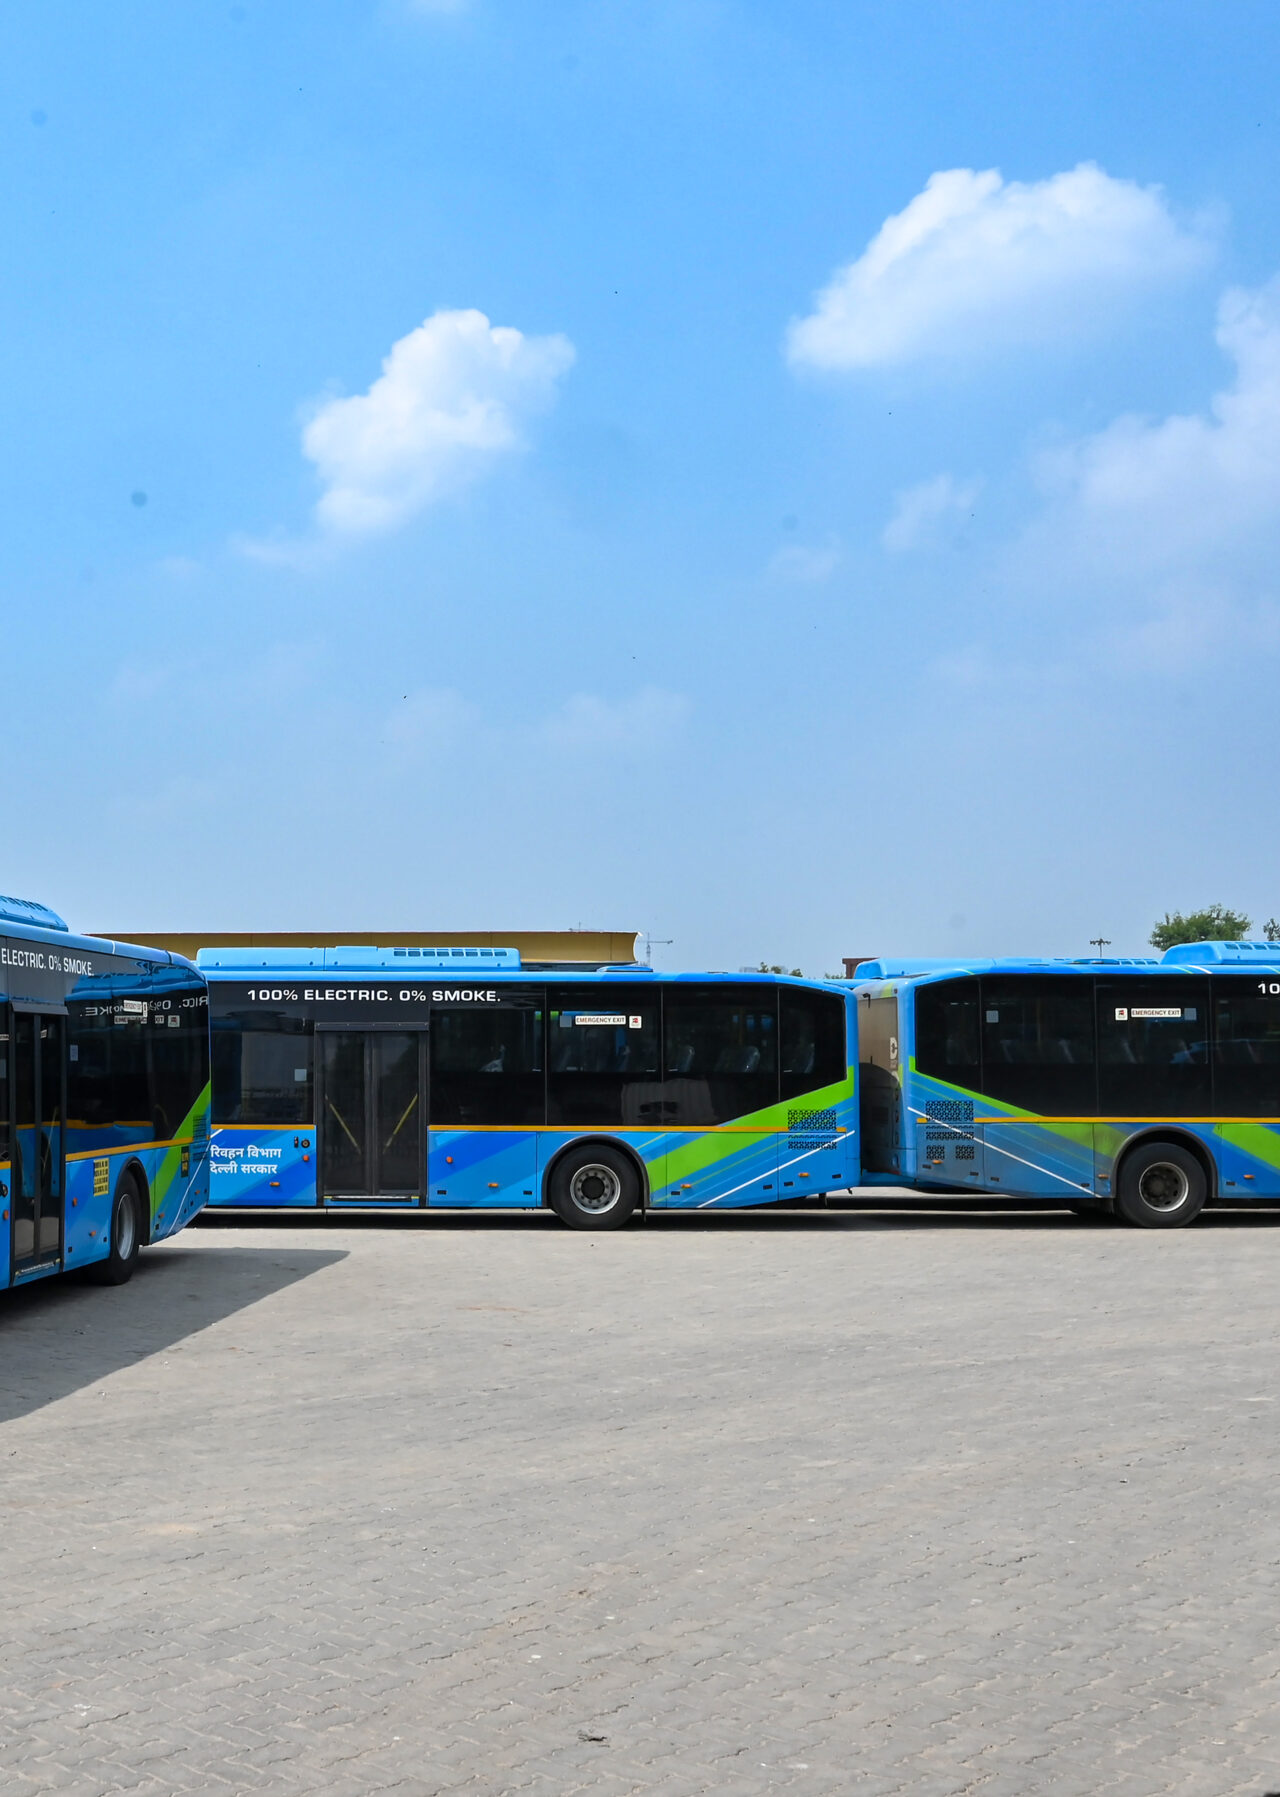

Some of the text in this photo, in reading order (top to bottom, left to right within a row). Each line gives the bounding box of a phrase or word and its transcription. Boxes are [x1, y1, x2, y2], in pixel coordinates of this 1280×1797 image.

[1, 947, 47, 969] ELECTRIC.
[48, 955, 62, 972] 0%
[63, 957, 95, 976] SMOKE.
[247, 989, 501, 1002] 100% ELECTRIC. 0% SMOKE.
[576, 1016, 625, 1024] EMERGENCY EXIT
[209, 1144, 282, 1160] रिवहन विभाग
[240, 1164, 278, 1174] सरकार
